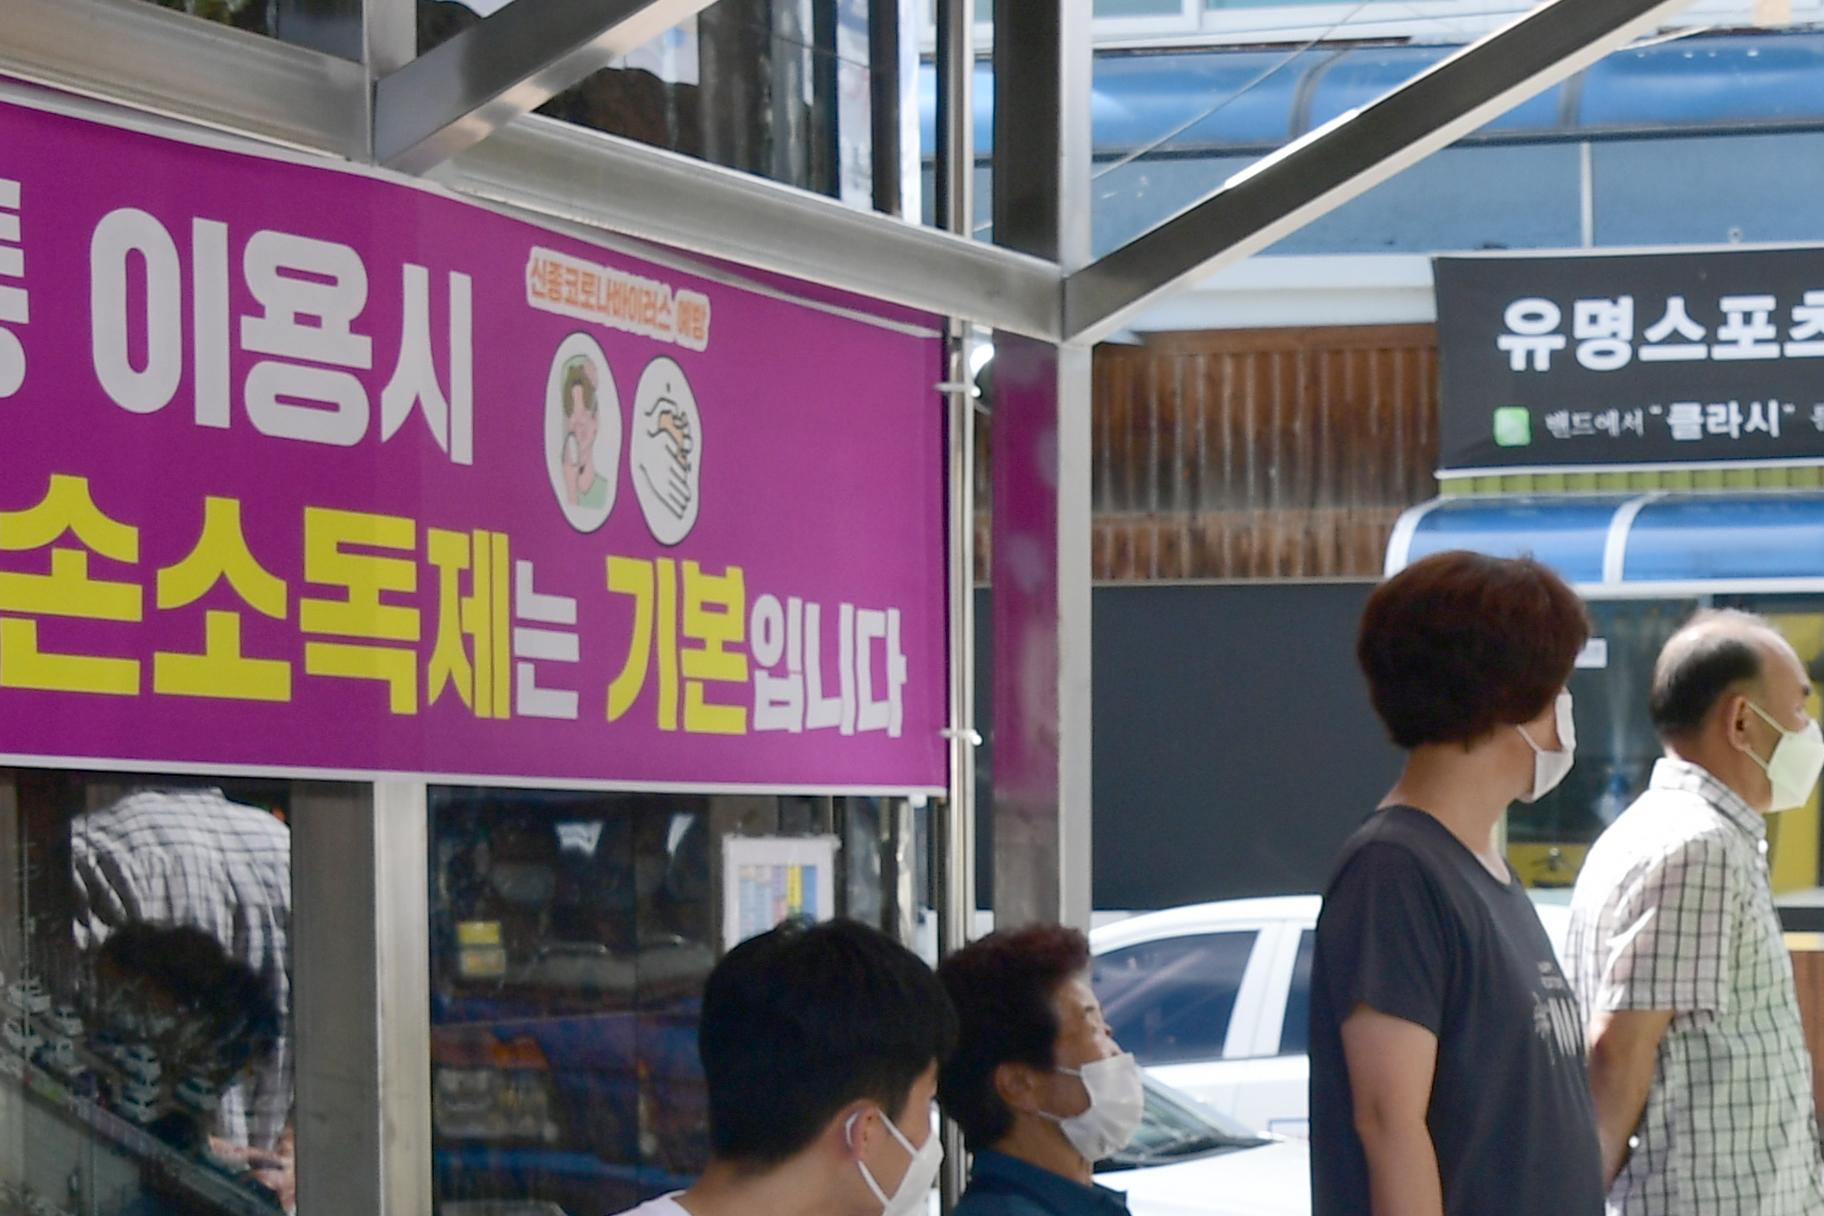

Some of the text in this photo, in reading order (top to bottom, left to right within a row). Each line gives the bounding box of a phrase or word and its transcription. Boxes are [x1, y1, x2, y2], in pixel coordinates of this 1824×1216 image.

[90, 207, 474, 465] 이용시
[531, 257, 707, 341] 신종코로나바이러스 예방
[0, 474, 907, 738] 손소독제는 기본입니다
